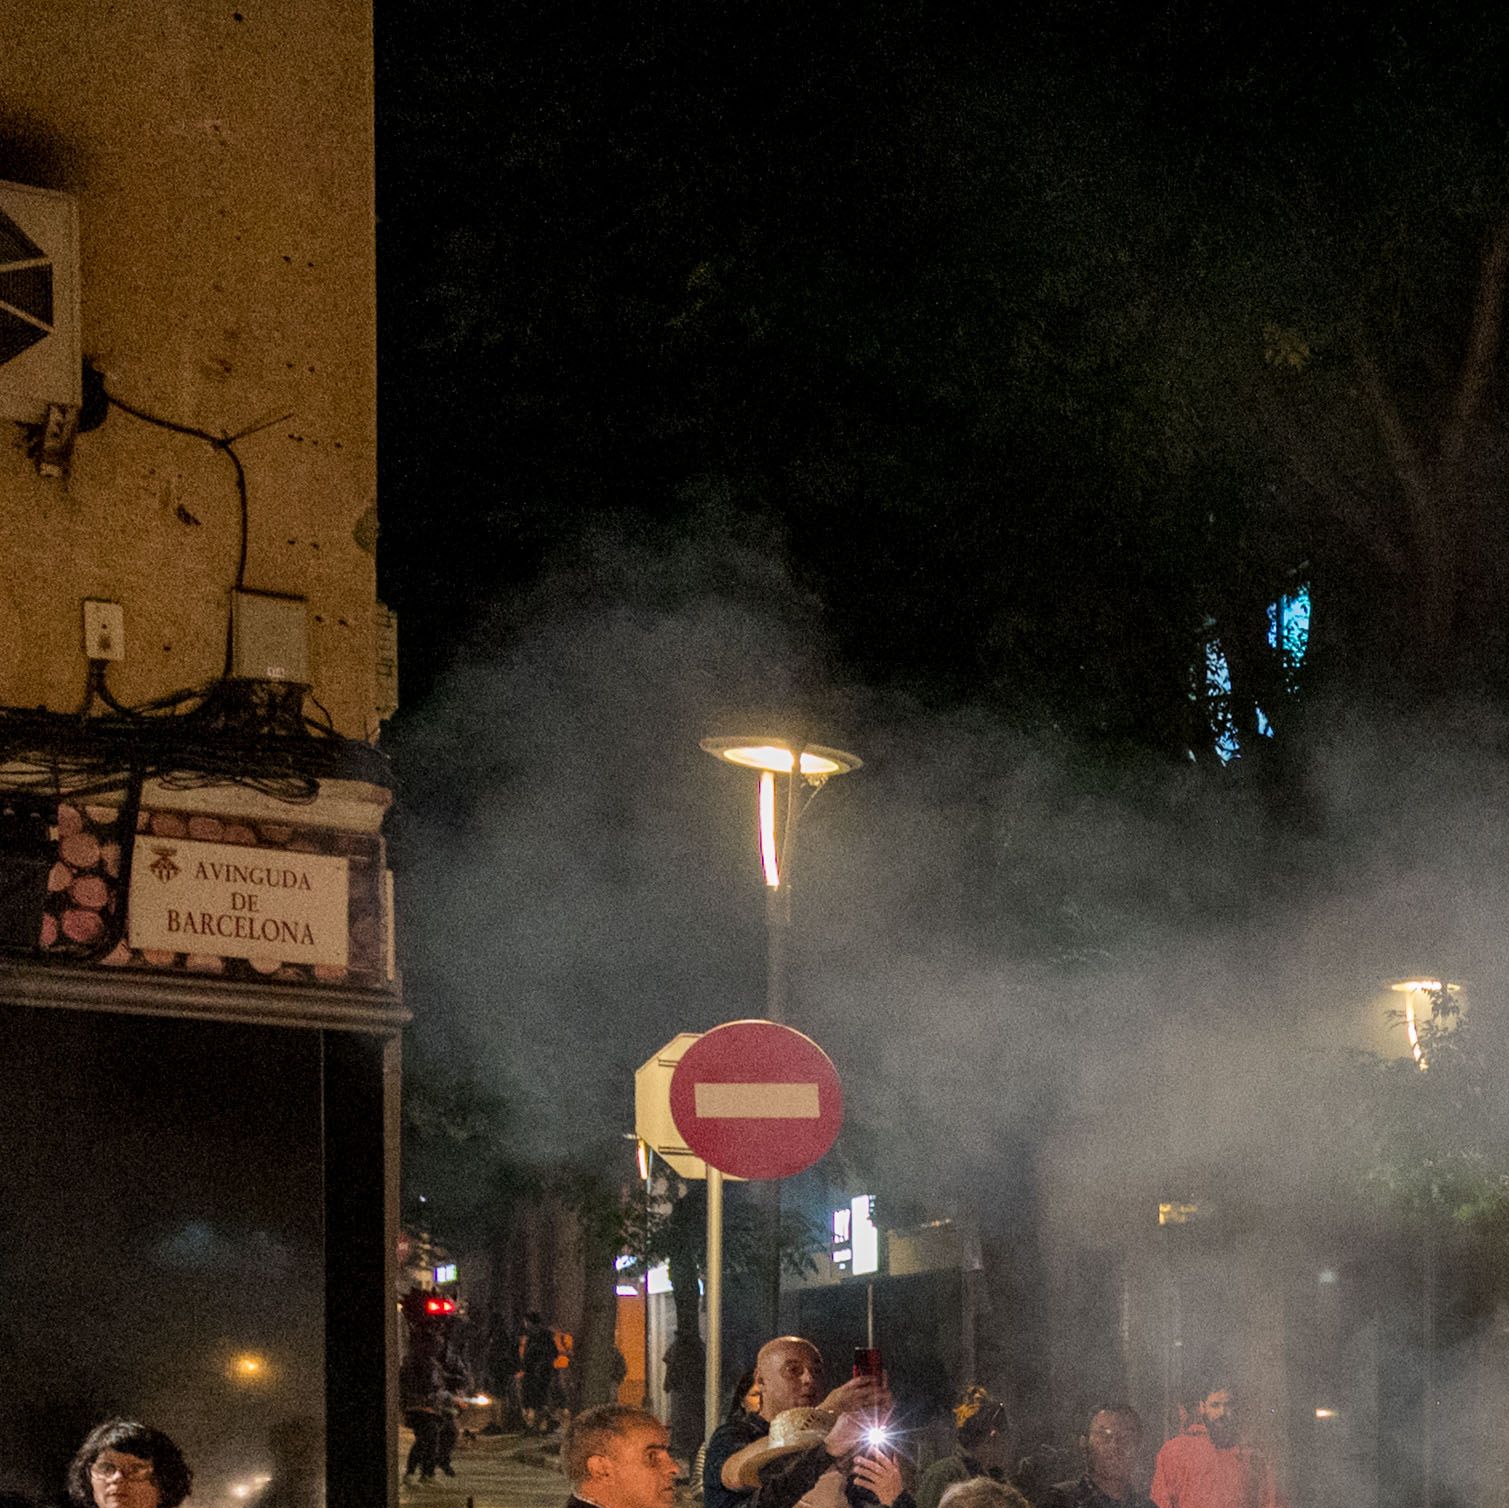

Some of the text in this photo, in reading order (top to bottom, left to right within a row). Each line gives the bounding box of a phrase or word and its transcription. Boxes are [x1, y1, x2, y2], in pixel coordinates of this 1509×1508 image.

[195, 861, 312, 892] AVINGUDA
[231, 892, 260, 913] DE
[167, 910, 315, 946] BARCELONA
